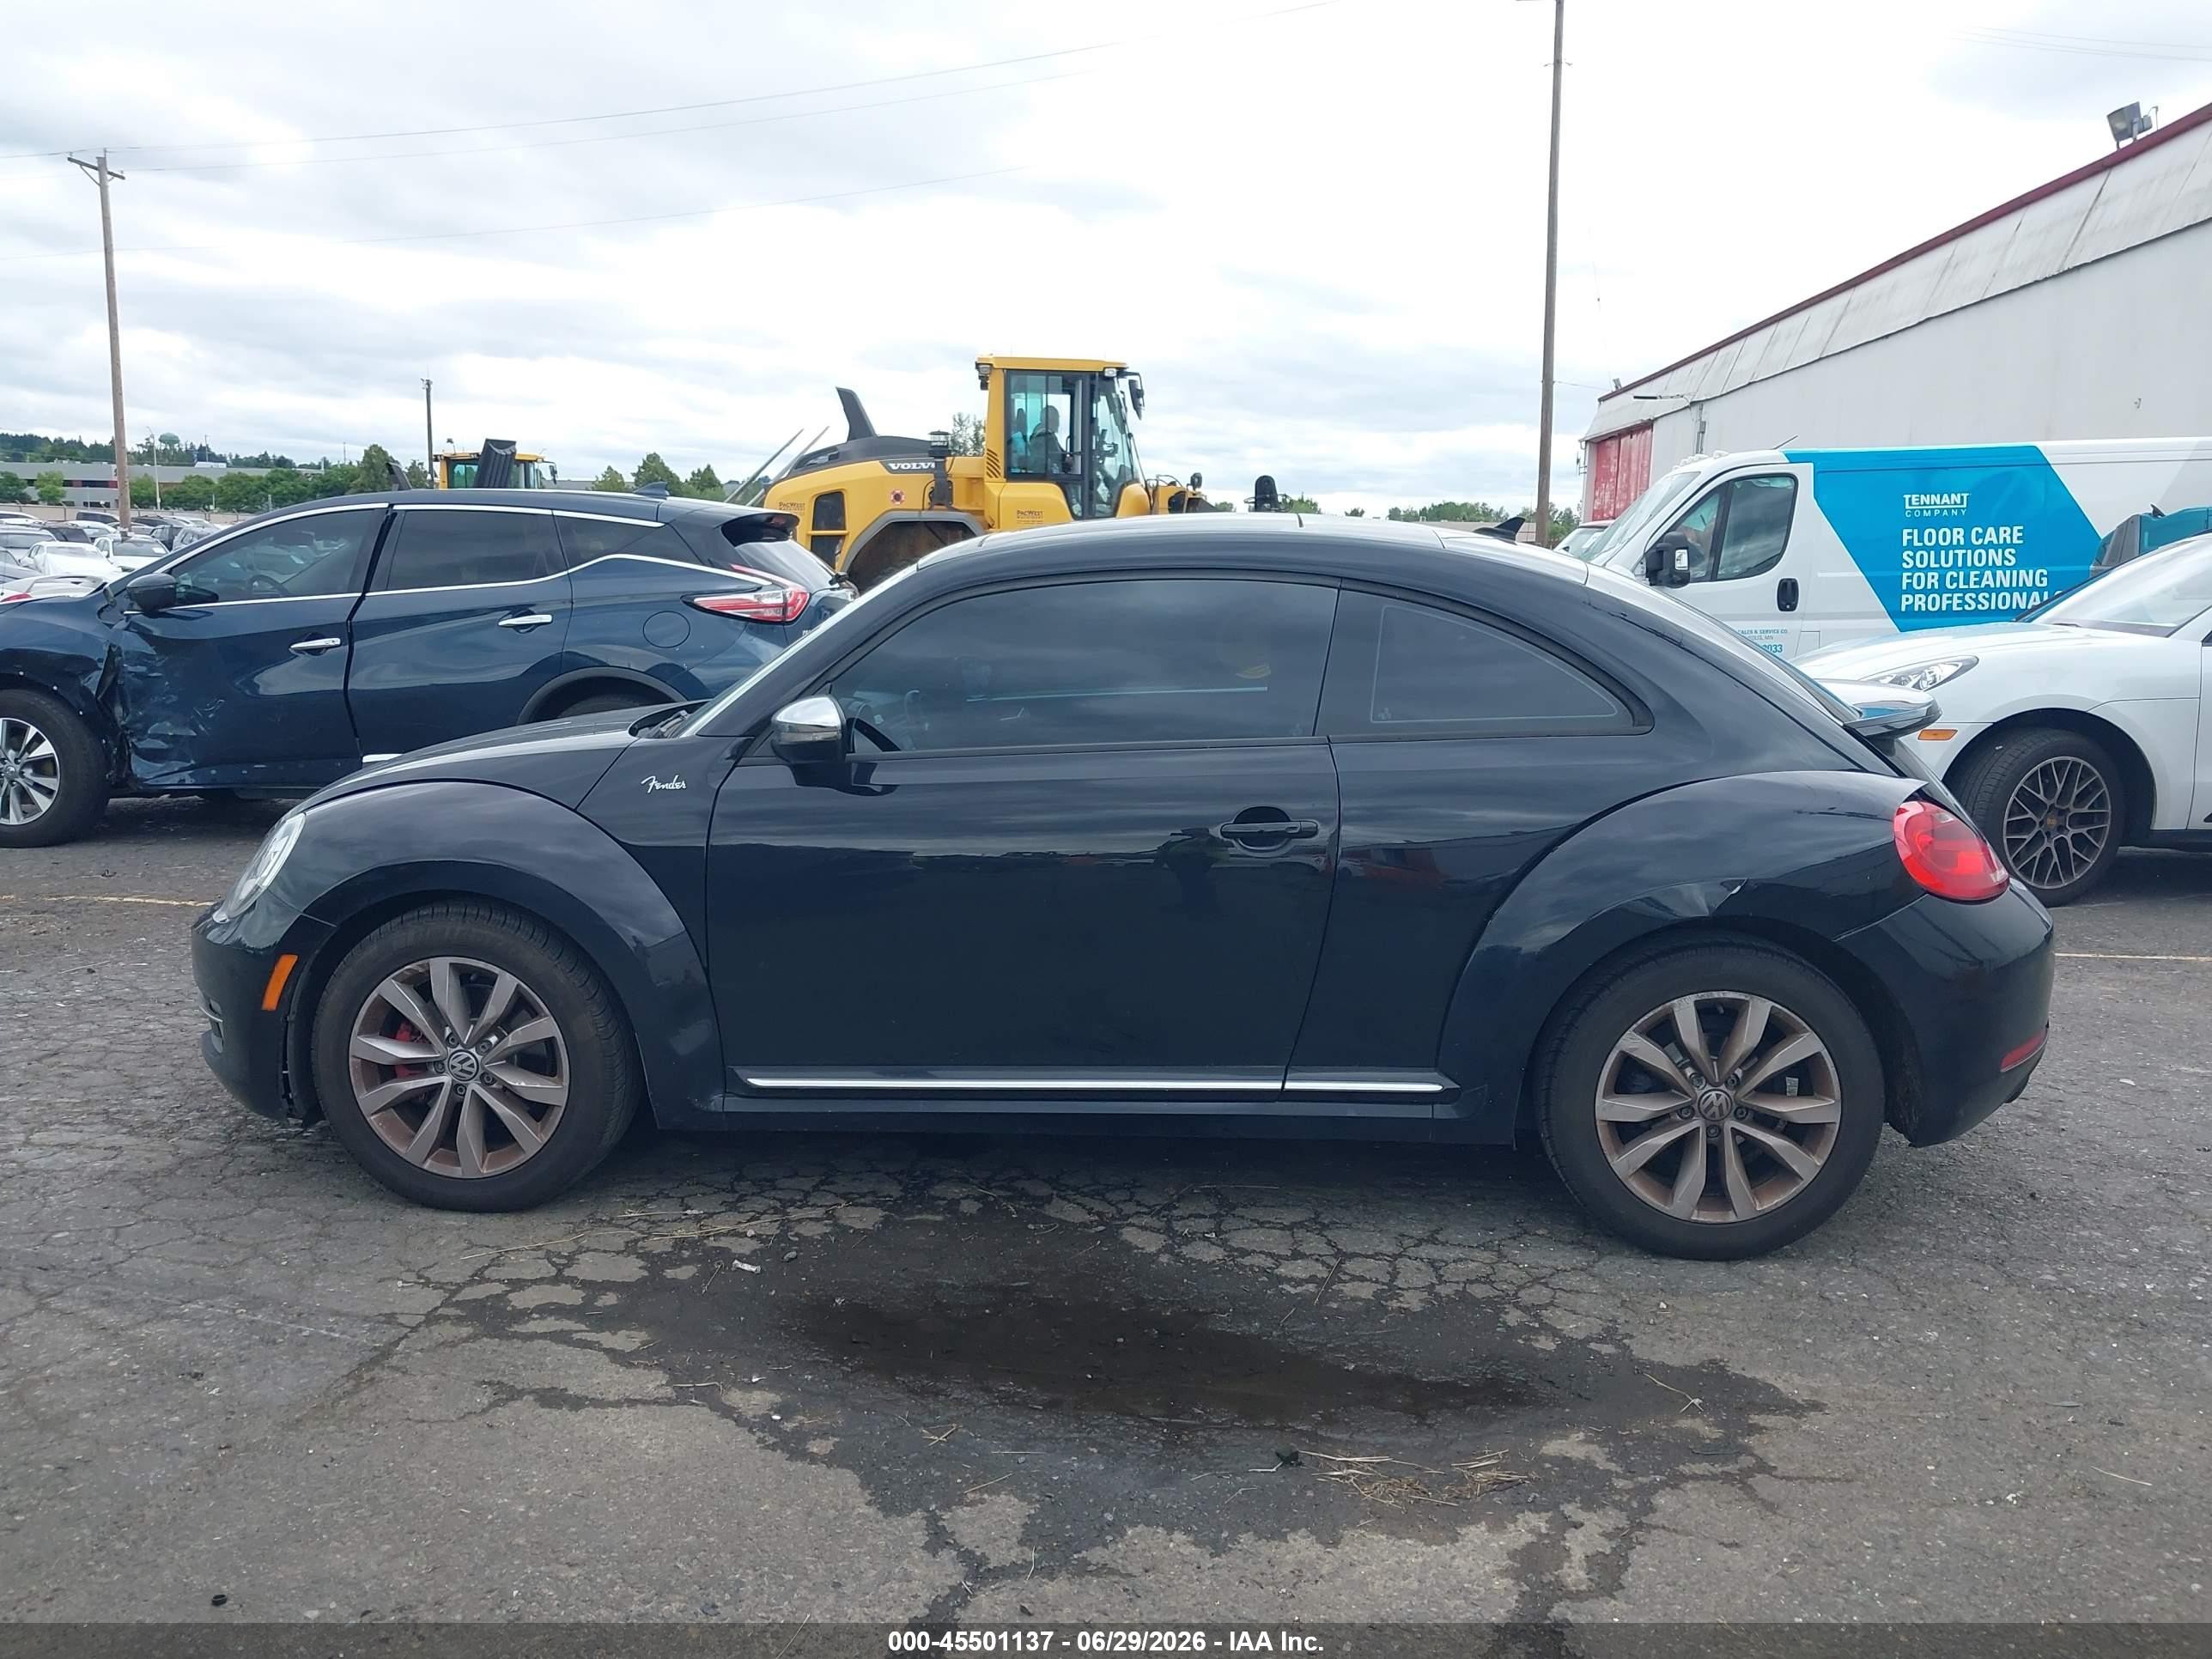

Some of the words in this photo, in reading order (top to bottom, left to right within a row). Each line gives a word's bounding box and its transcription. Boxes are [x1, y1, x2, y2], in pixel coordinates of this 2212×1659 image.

[1903, 493, 1970, 509] TENNANT
[1905, 508, 1966, 517] COMPANY
[1902, 527, 1965, 546] FLOOR
[1971, 526, 2024, 545] CARE
[1902, 549, 2016, 568] SOLUTIONS
[1901, 572, 1940, 591] FOR
[1945, 568, 2049, 589] CLEANING
[1900, 591, 2064, 612] PROFESSIONA
[641, 775, 687, 793] Fender
